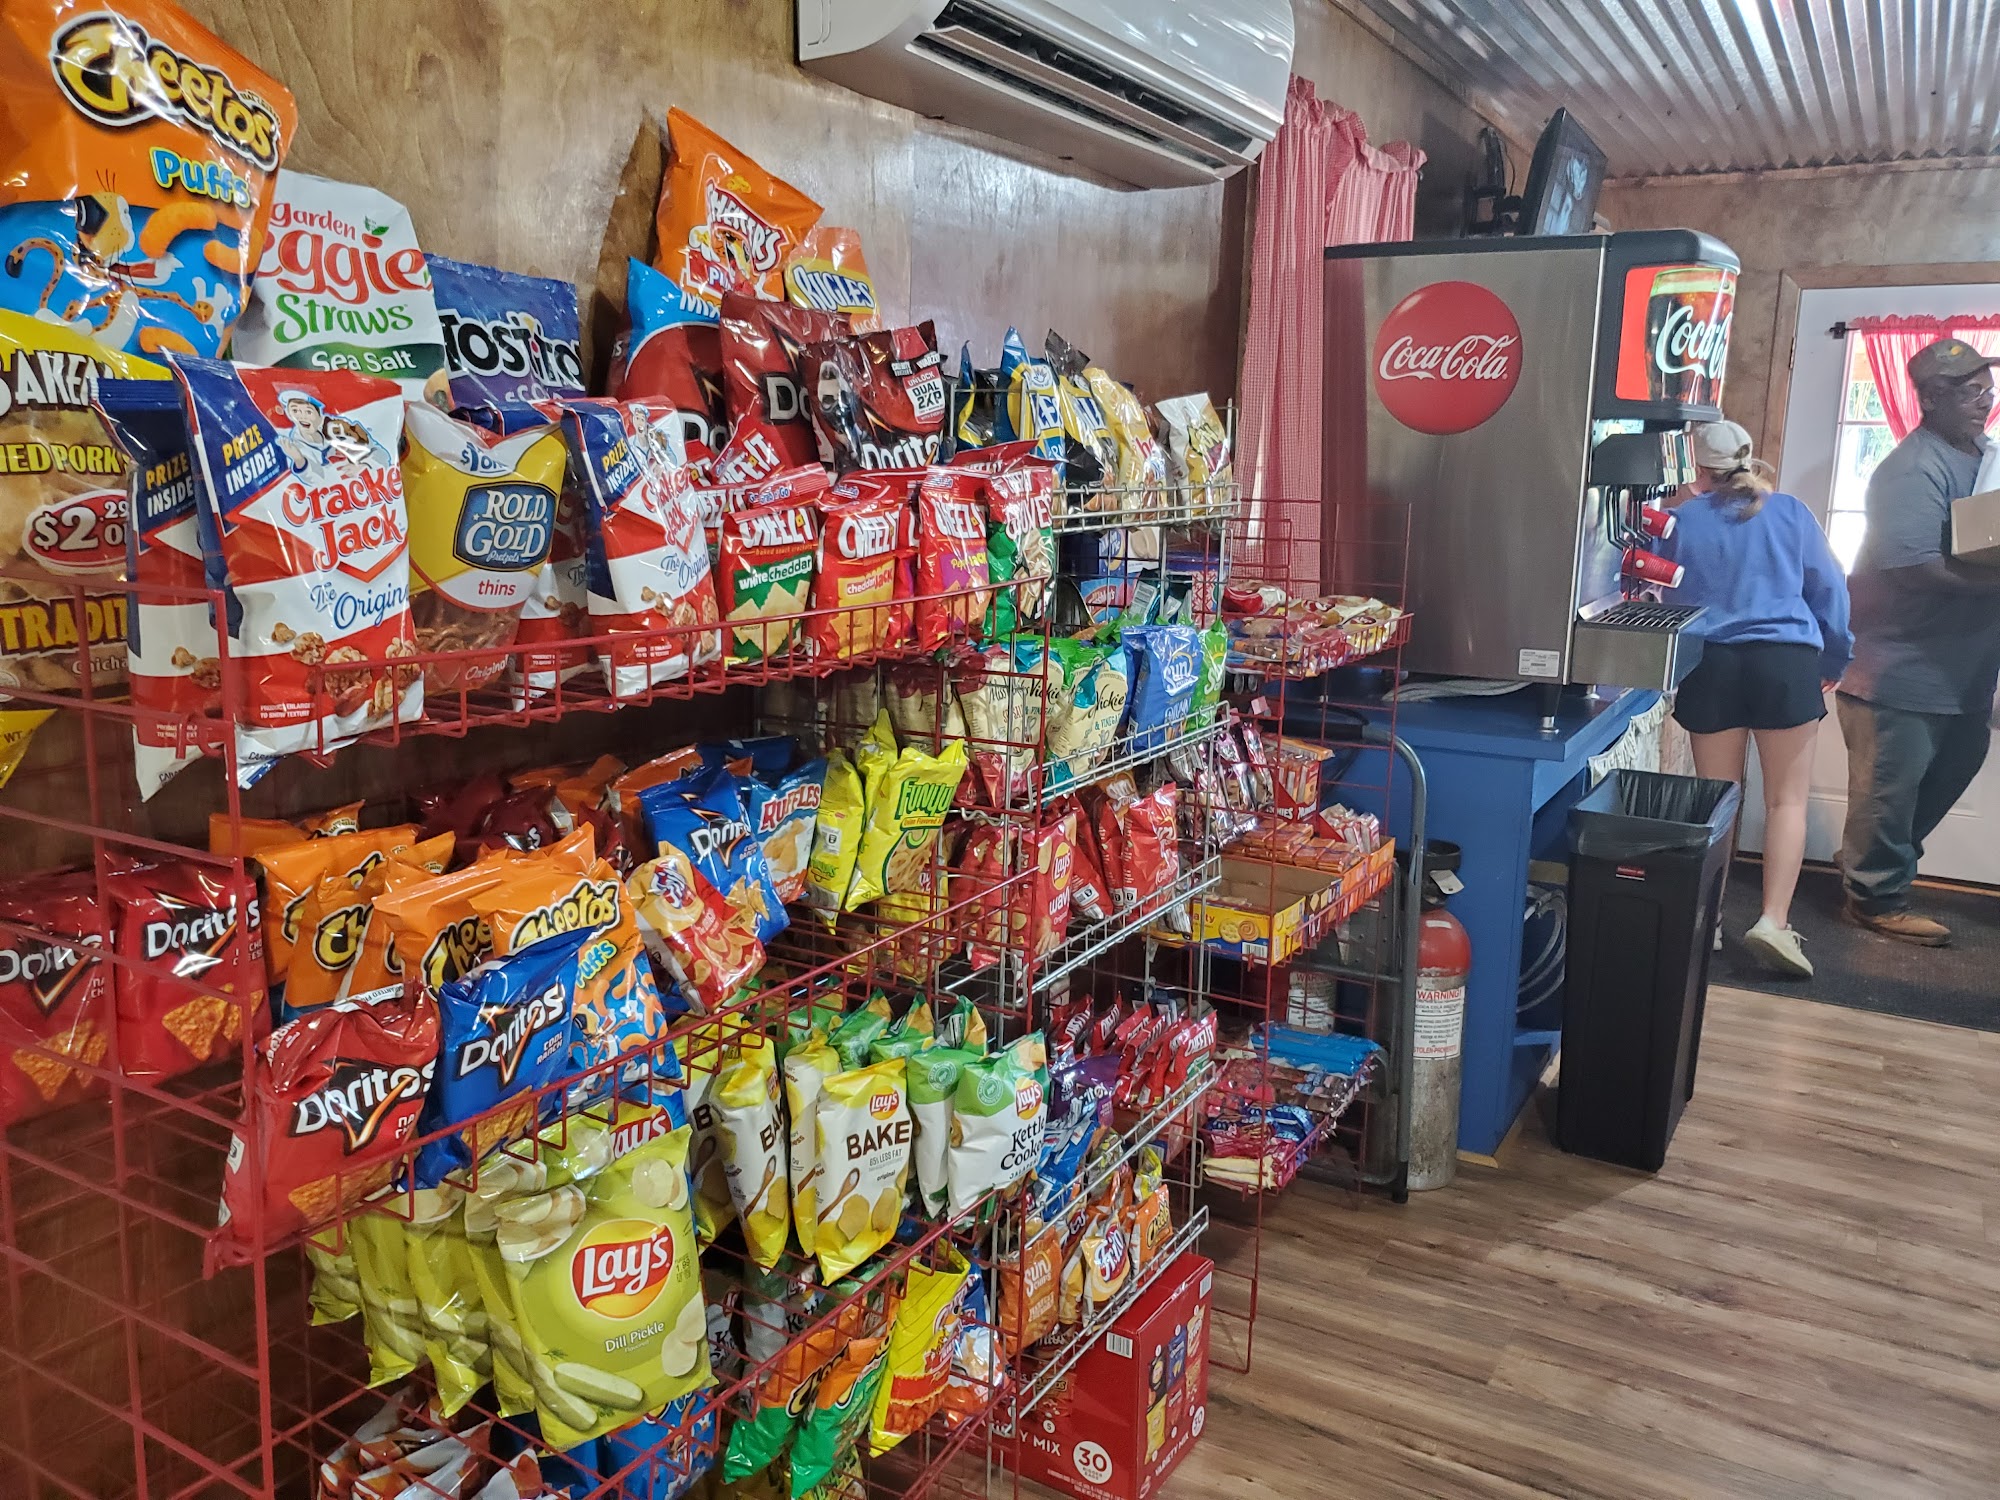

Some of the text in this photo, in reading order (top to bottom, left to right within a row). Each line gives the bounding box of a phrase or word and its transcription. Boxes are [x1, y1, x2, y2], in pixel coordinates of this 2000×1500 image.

[151, 147, 251, 208] Puffs
[270, 203, 356, 241] garden
[793, 264, 875, 311] BUGLES
[273, 293, 414, 344] Straws
[1379, 334, 1518, 382] Coca-Cola
[1655, 305, 1734, 379] Coca-C
[311, 350, 417, 374] Sea Salt
[908, 371, 935, 387] UNLOCK
[912, 380, 940, 397] DUAL
[917, 391, 943, 409] 2XP
[222, 424, 264, 467] PRIZE
[602, 437, 628, 472] PRIZE
[146, 452, 189, 491] PRIZE
[225, 442, 277, 495] INSIDE!
[482, 490, 547, 524] ROLD
[313, 503, 404, 572] Jack
[464, 520, 547, 558] GOLD
[768, 555, 813, 583] cheddar
[310, 581, 338, 613] The
[478, 579, 517, 597] thins
[847, 577, 875, 596] cheddar
[464, 654, 510, 681] Original
[761, 783, 822, 831] RUFFLES
[1418, 990, 1461, 1000] WARNING!
[460, 983, 566, 1077] Doritos
[543, 1031, 563, 1050] COOL
[536, 1039, 563, 1065] RANCH
[295, 1058, 437, 1134] Doritos
[870, 1090, 899, 1113] Lay's
[1016, 1082, 1041, 1112] Lay's
[846, 1119, 912, 1161] BAKE
[876, 1170, 897, 1182] original
[582, 1233, 669, 1297] Lay's
[1024, 1257, 1052, 1297] Sun
[604, 1321, 665, 1353] Dill Pickle
[1033, 1436, 1061, 1457] MIX
[1078, 1446, 1107, 1472] 30
